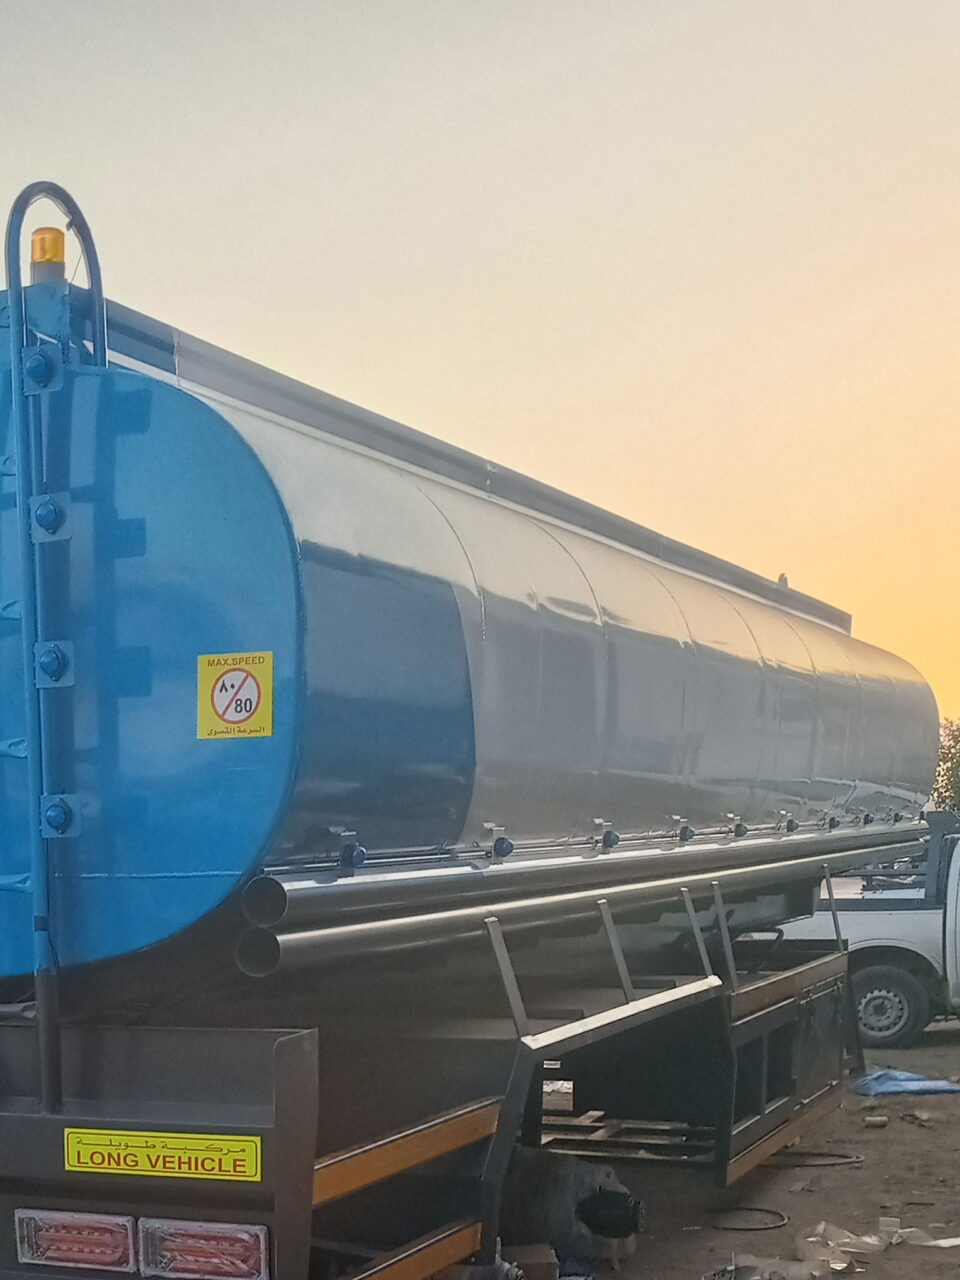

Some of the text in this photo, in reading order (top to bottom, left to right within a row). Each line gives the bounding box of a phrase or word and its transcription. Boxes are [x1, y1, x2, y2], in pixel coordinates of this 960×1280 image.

[234, 698, 253, 713] 80
[207, 726, 265, 736] السرعة القصوى
[76, 1136, 246, 1155] مركبة طويلة
[76, 1150, 247, 1174] LONG VEHICLE
